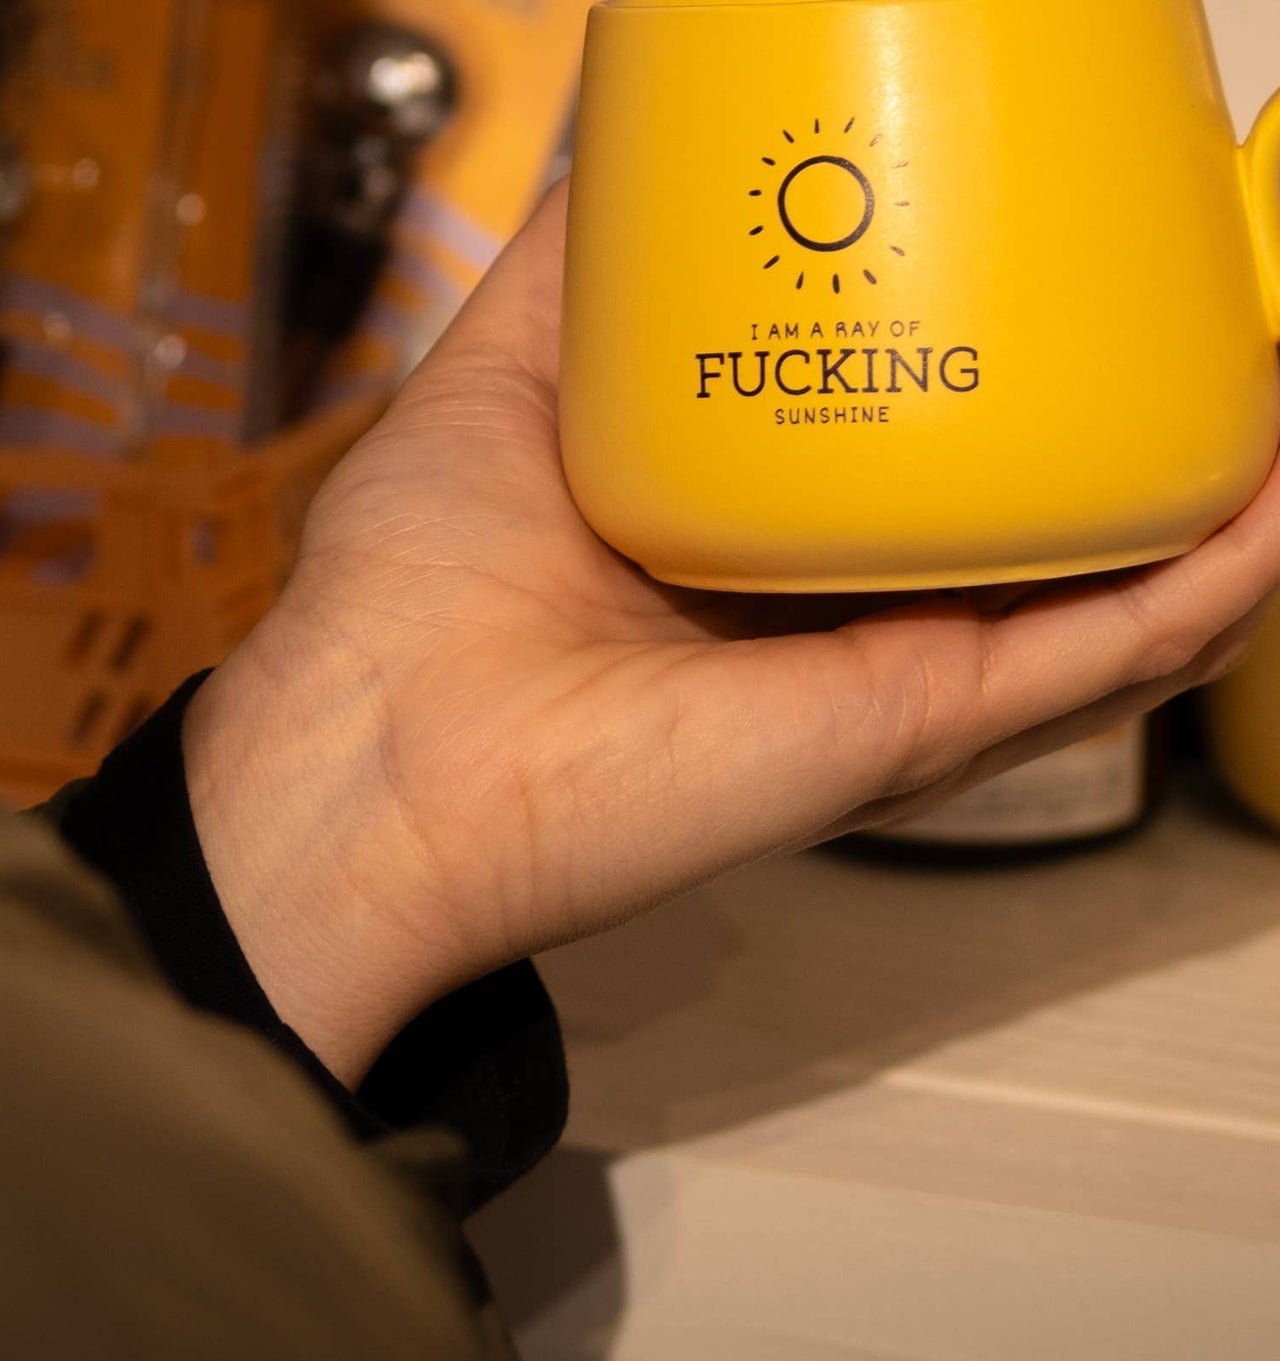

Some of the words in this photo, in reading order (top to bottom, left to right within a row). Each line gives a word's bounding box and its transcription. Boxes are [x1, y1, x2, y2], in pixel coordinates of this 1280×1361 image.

[751, 323, 758, 340] I
[768, 322, 799, 340] AM
[810, 322, 824, 339] A
[835, 320, 880, 338] RAY
[890, 320, 921, 337] OF
[695, 345, 980, 399] FUCKING
[774, 406, 890, 425] SUNSHINE
